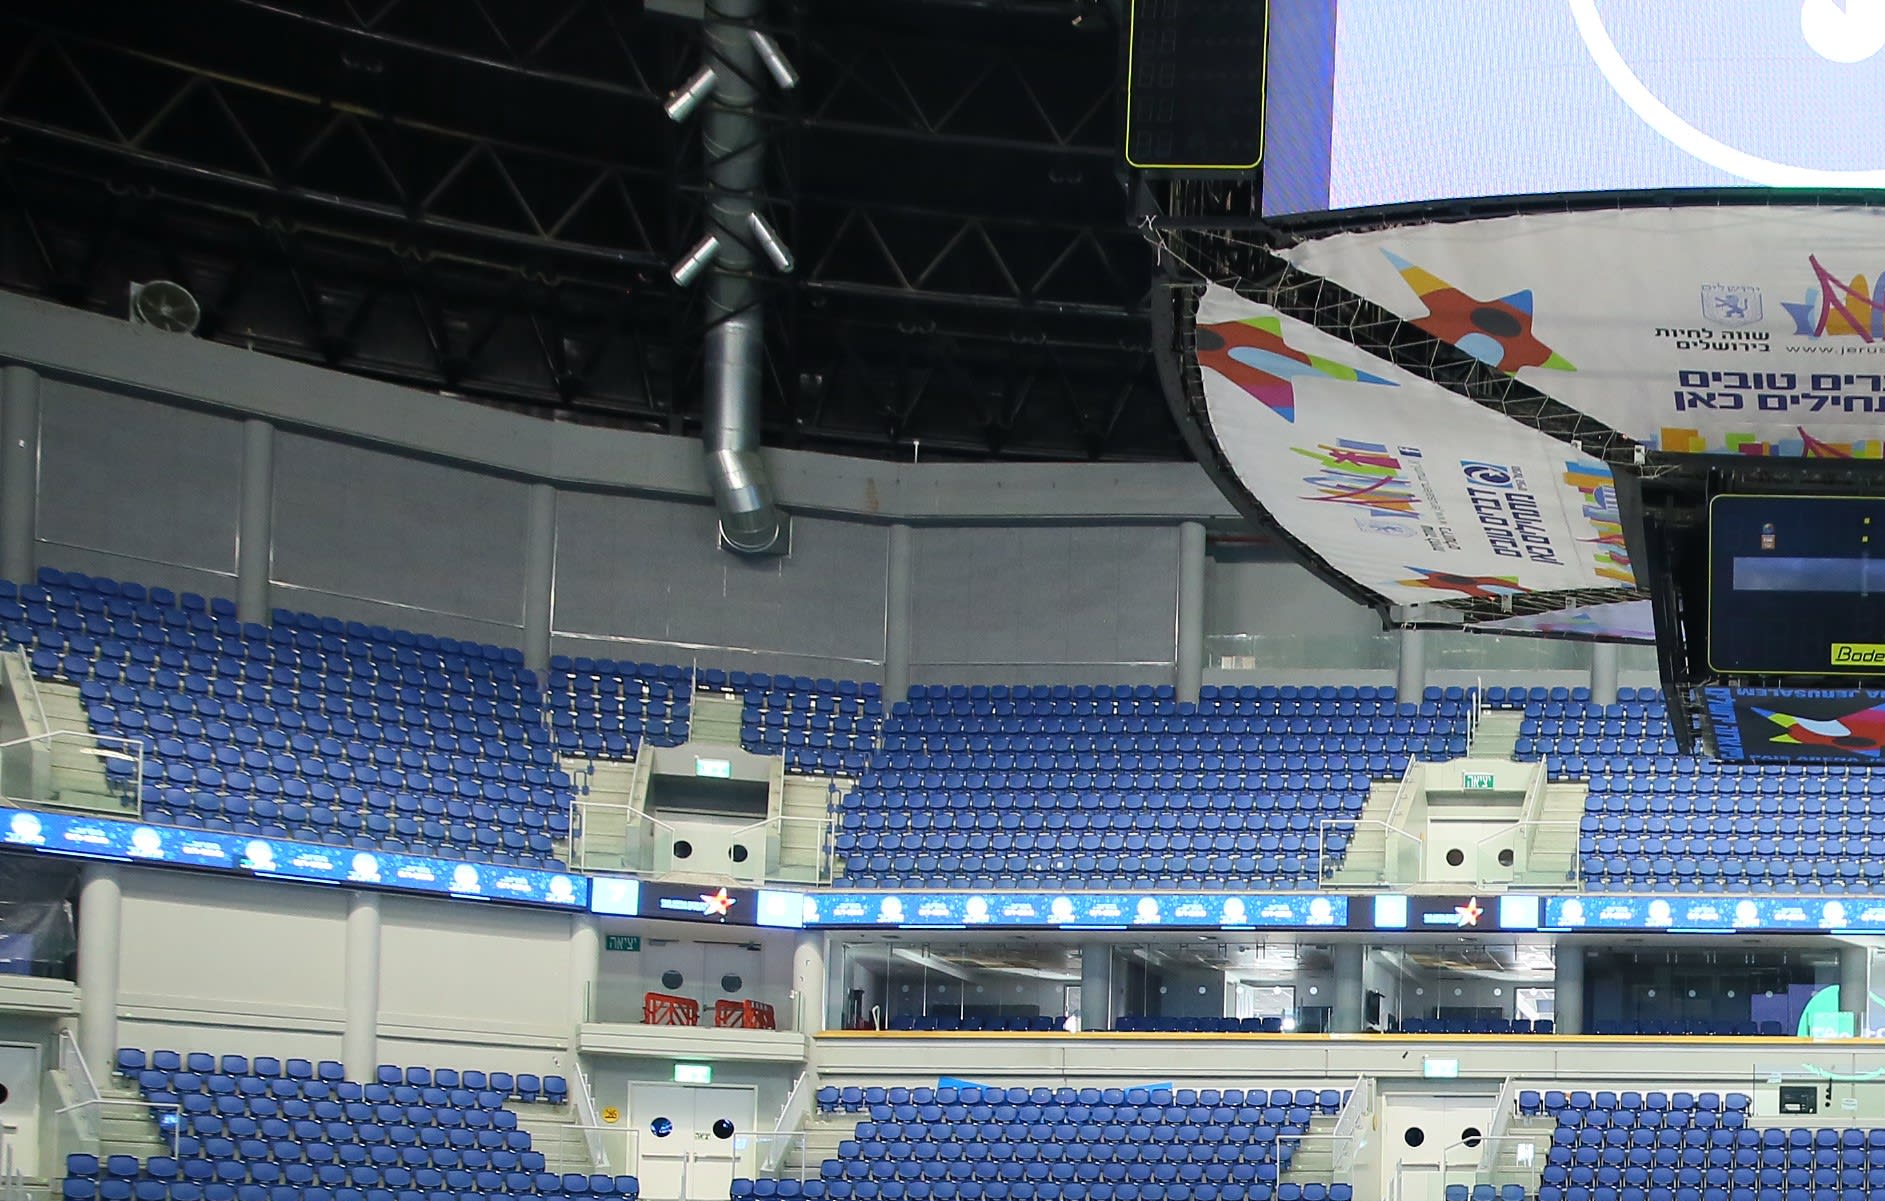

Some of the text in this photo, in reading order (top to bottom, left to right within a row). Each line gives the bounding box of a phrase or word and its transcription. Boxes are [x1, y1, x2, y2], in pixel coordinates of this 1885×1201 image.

[1655, 327, 1770, 341] שווה לחיות
[1676, 340, 1770, 352] בירושלים
[1678, 370, 1797, 391] טובים
[1674, 391, 1744, 412] כאן
[1466, 487, 1523, 558] דברים טובים
[1505, 492, 1565, 566] מתחילים כאן
[1737, 687, 1860, 698] JERUSALEM
[1467, 775, 1492, 788] יציאה
[610, 937, 637, 950] יציאה
